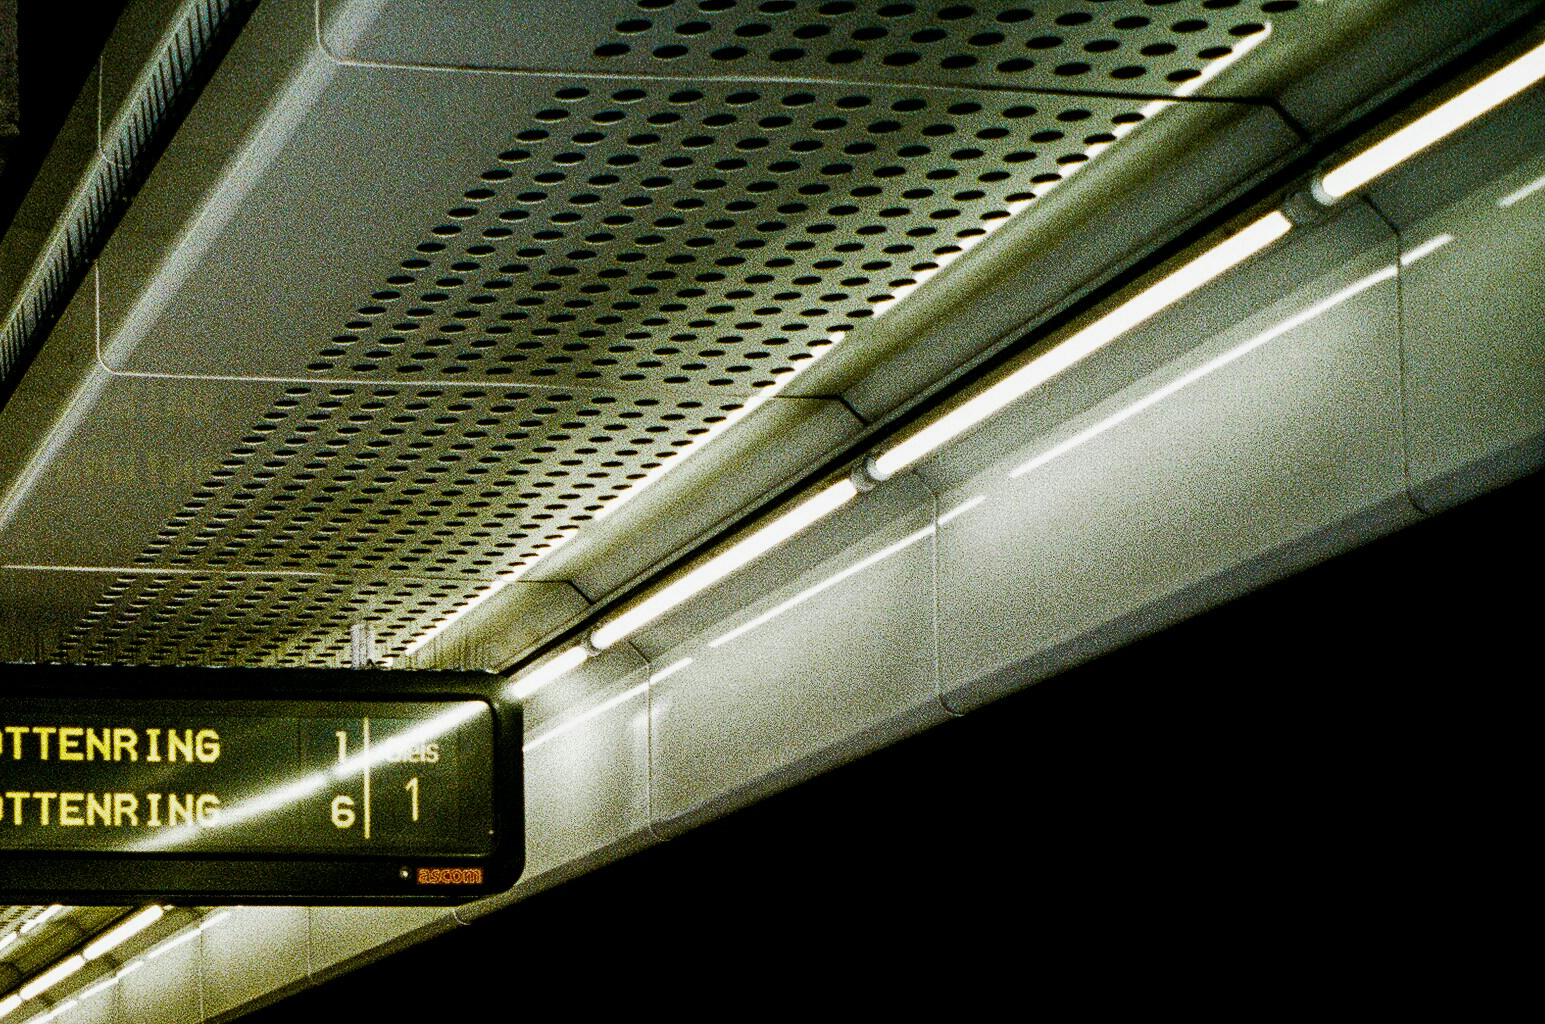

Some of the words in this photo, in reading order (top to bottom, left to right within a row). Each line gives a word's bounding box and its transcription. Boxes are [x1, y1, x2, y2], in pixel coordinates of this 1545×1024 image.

[335, 730, 348, 764] 1
[330, 794, 356, 829] 6
[405, 777, 419, 821] 1
[417, 868, 482, 884] ascom
